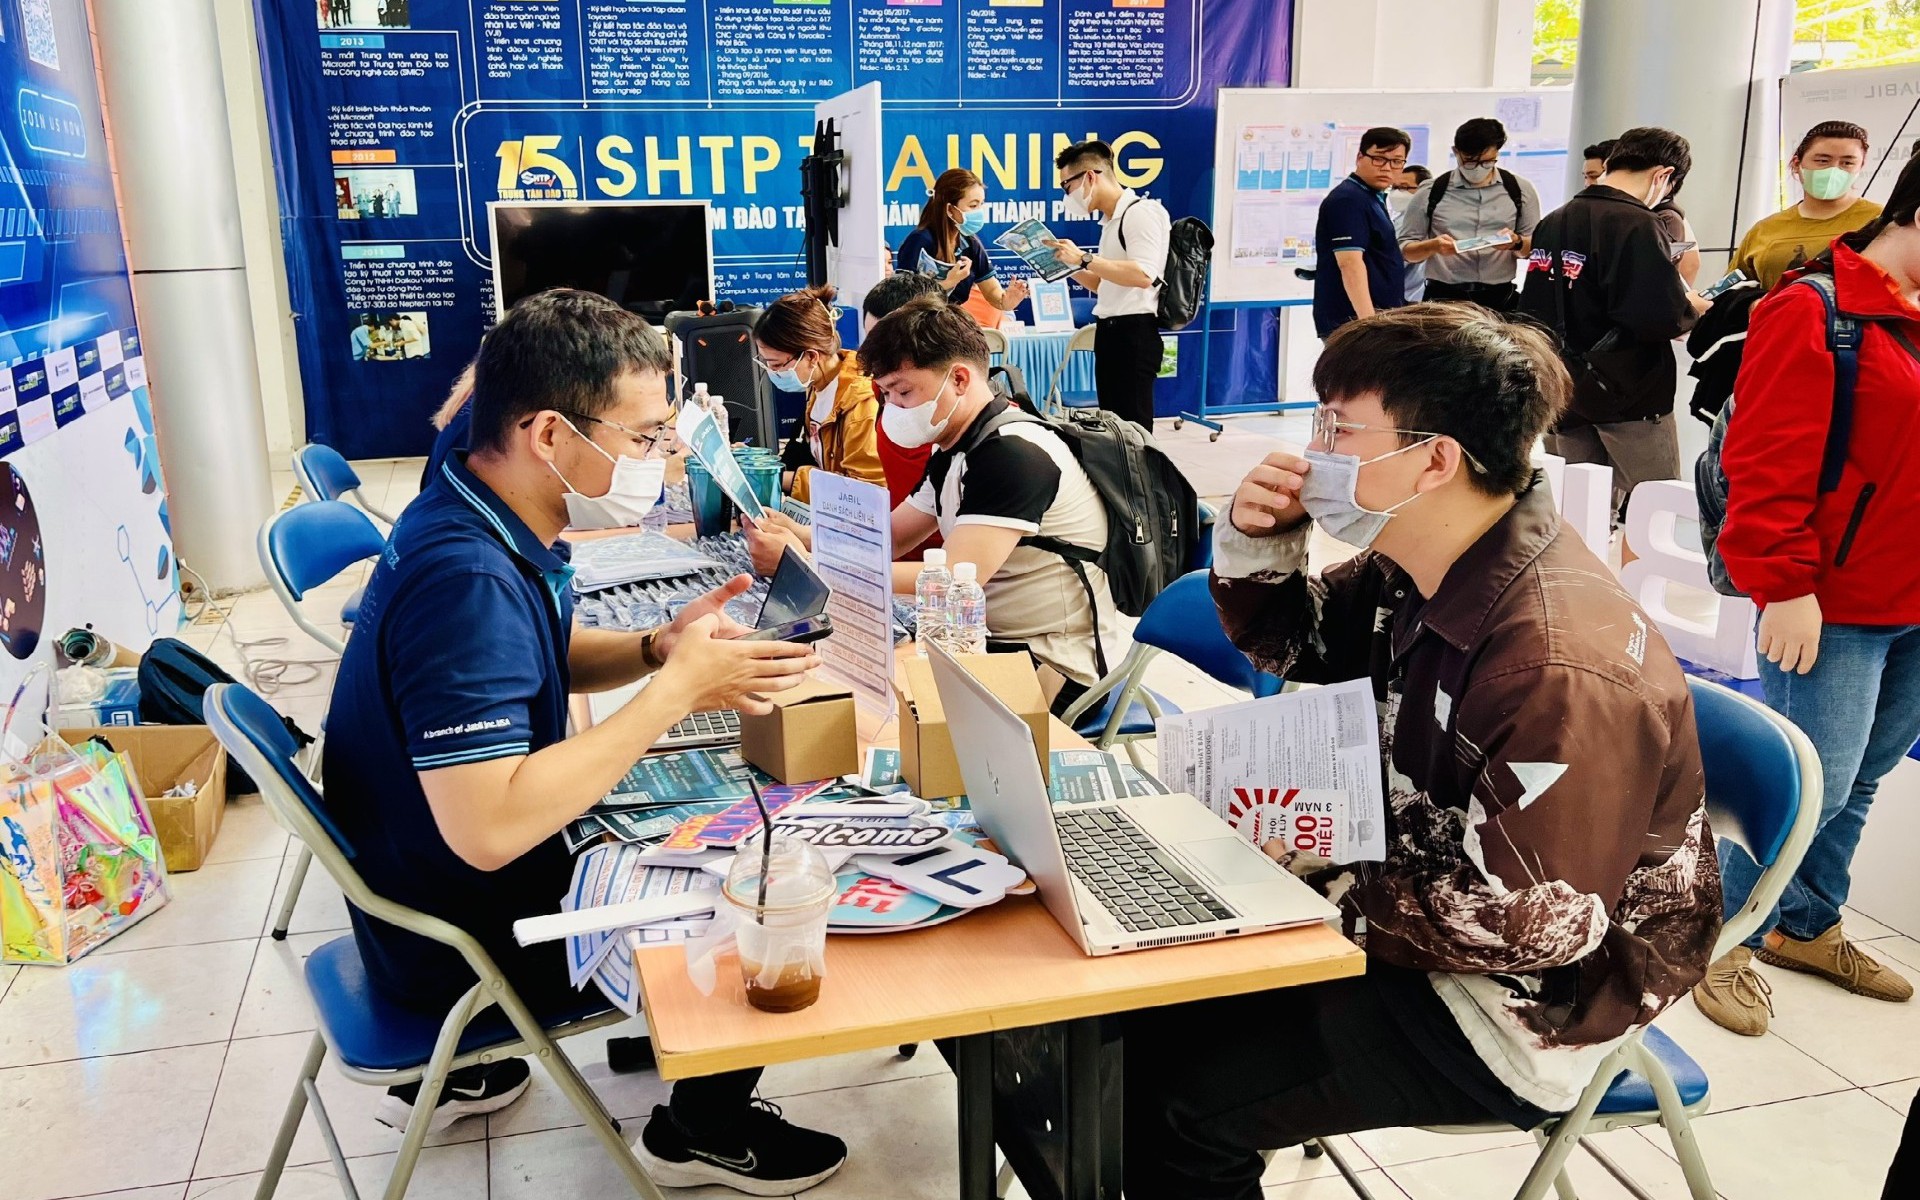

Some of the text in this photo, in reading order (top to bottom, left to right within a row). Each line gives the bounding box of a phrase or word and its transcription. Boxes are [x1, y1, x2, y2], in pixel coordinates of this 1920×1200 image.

[23, 108, 46, 130] JOIN
[49, 117, 61, 132] US
[495, 135, 578, 190] 15
[595, 135, 781, 197] SHTP
[732, 204, 776, 229] ĐÀO
[782, 206, 807, 232] TẠ
[838, 492, 861, 505] JABIL
[428, 726, 454, 738] branch
[454, 724, 463, 734] of
[464, 722, 483, 732] Jabil
[1326, 803, 1332, 812] 3
[1294, 815, 1317, 850] 00
[1316, 817, 1335, 857] RIỆU
